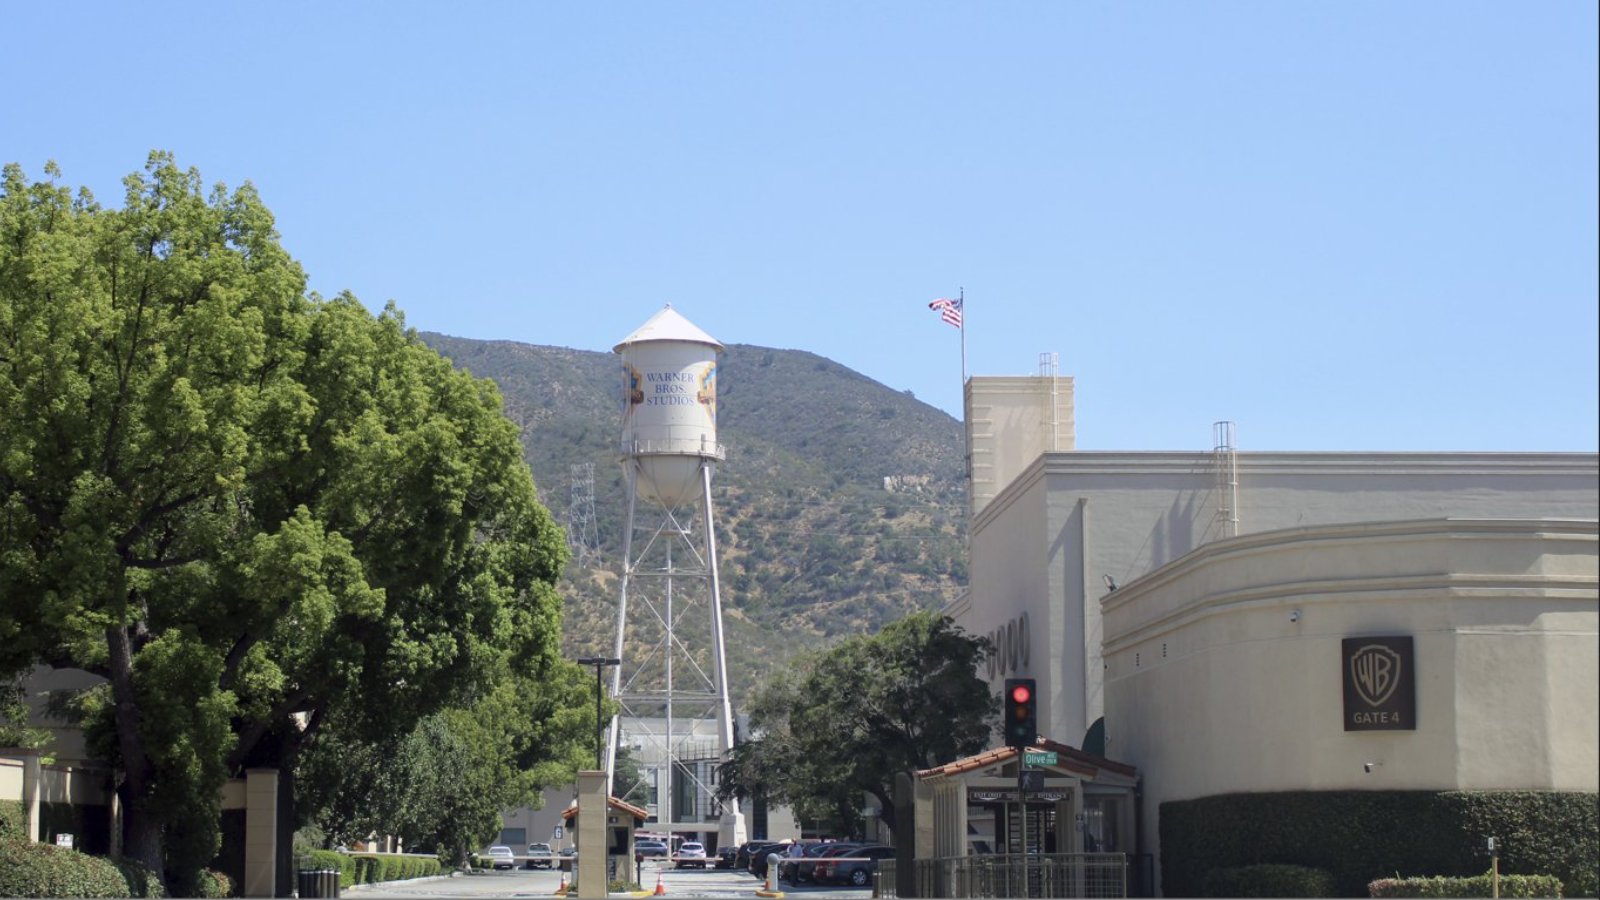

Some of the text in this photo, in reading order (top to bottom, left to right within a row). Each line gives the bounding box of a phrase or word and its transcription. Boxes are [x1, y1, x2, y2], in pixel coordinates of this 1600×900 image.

[647, 372, 694, 382] WARNER
[655, 384, 687, 394] BROS.
[646, 396, 695, 406] STUDIOS
[1357, 653, 1391, 697] WB
[1354, 711, 1400, 724] GATE 4
[1025, 754, 1046, 765] Olive
